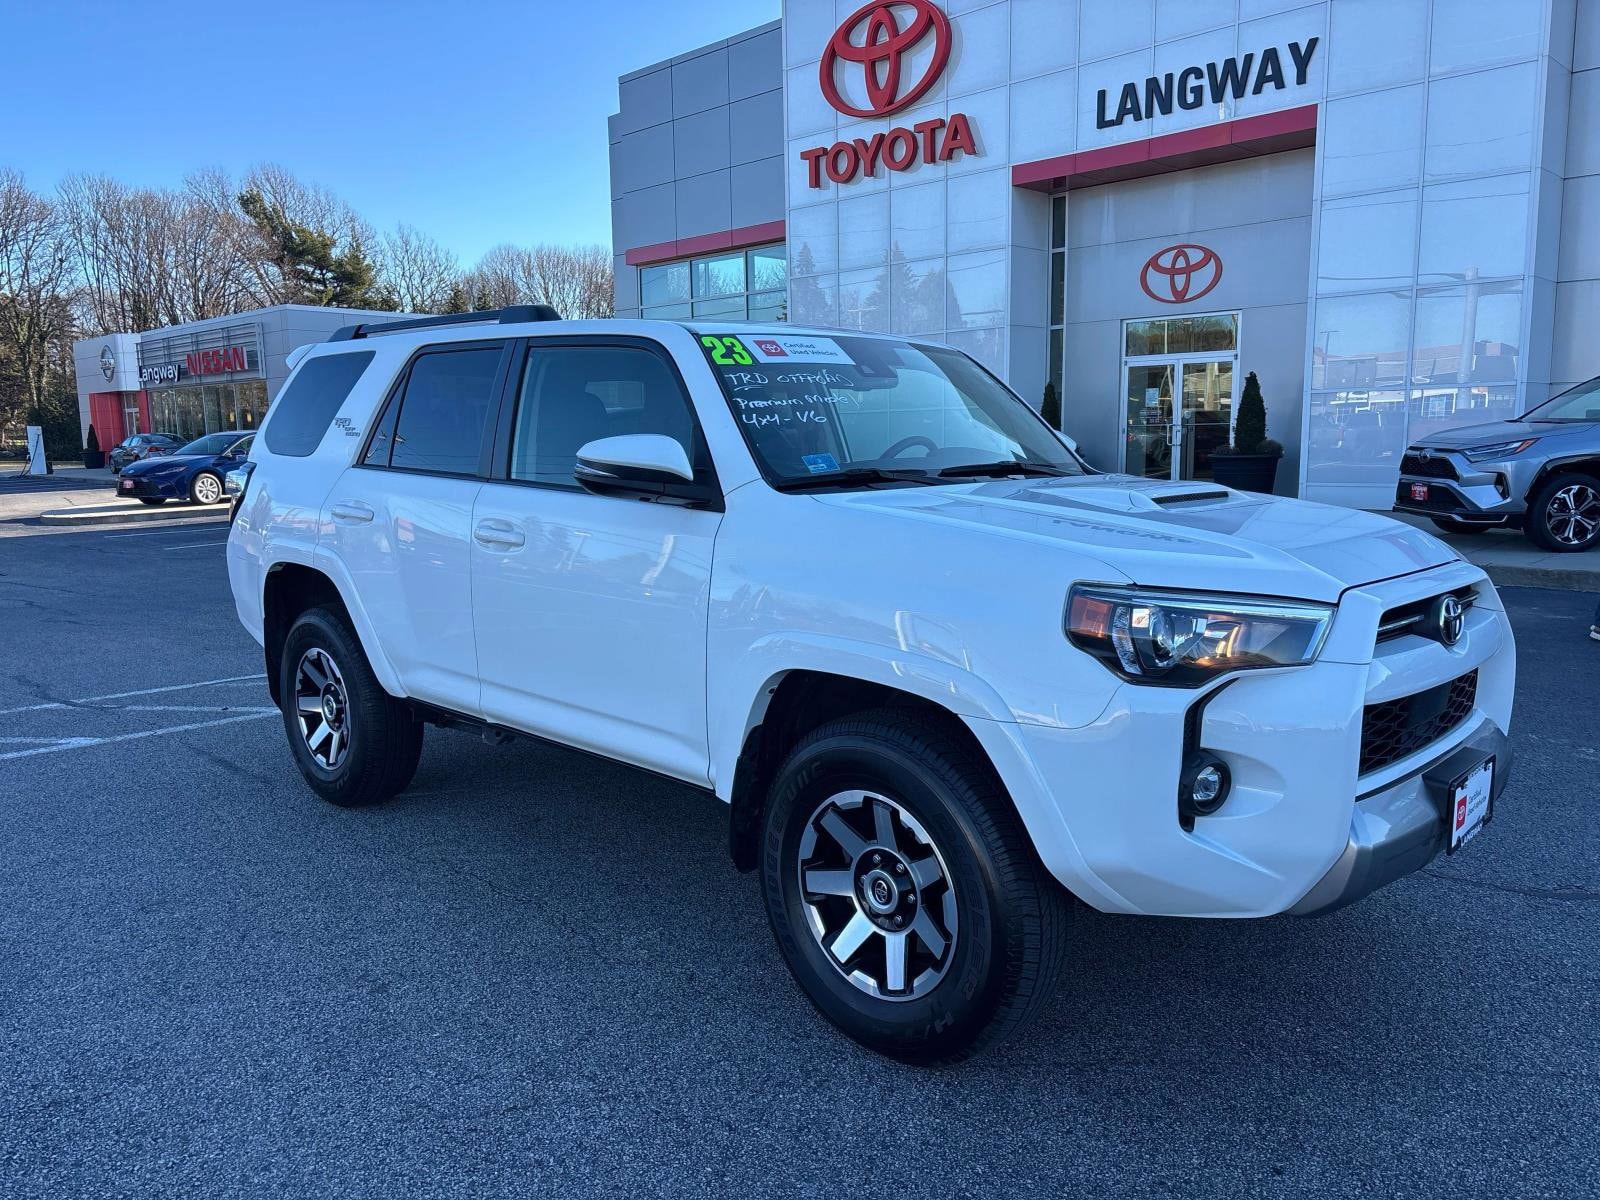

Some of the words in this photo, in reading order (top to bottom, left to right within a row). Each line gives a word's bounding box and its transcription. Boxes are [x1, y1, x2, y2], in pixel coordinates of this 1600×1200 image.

[1096, 37, 1320, 130] LANGWAY
[800, 113, 978, 189] TOYOTA
[138, 364, 181, 384] Langway
[186, 347, 247, 376] NISSAN
[701, 336, 752, 365] 23
[724, 372, 769, 386] TRD
